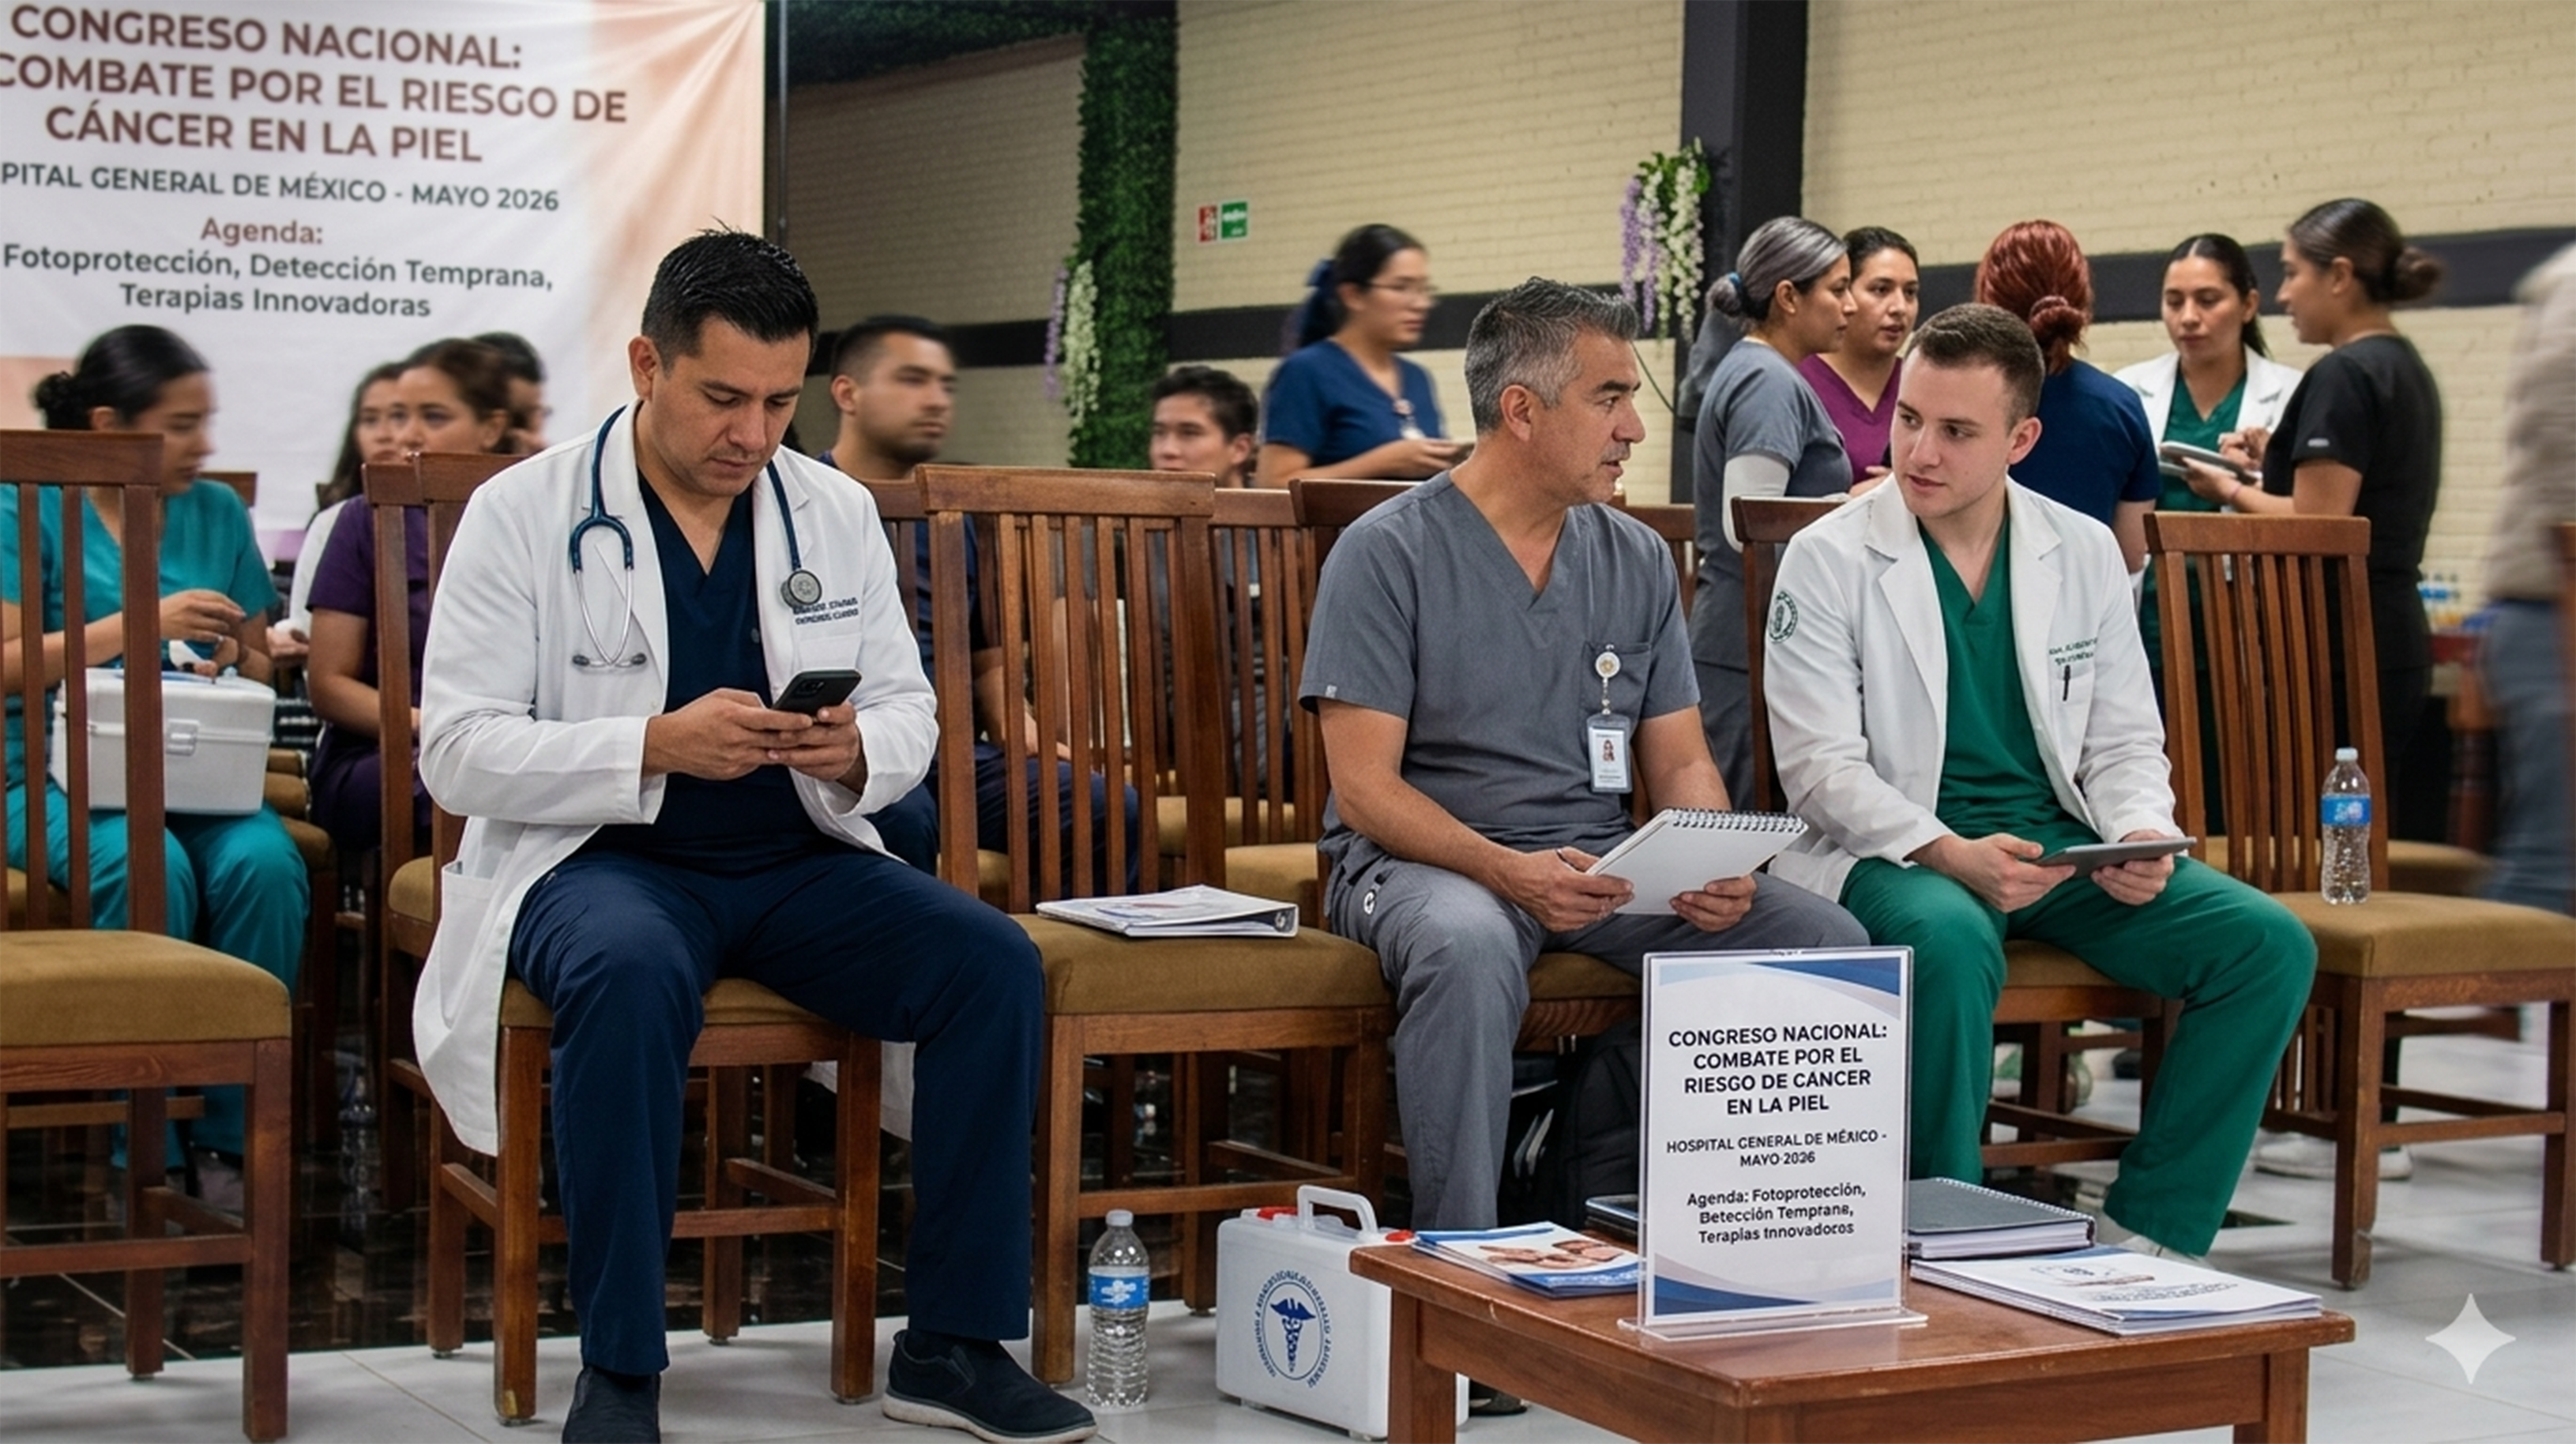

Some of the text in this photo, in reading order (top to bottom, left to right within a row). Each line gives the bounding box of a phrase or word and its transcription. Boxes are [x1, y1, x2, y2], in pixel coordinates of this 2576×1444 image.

[11, 4, 521, 69] CONGRESO NACIONAL:
[0, 52, 626, 123] COMBATE POR EL RIESGO DE
[46, 99, 482, 162] CÁNCER EN LA PIEL
[91, 166, 224, 194] GENERAL
[232, 173, 269, 197] DE
[279, 172, 386, 203] MÉXICO
[412, 184, 490, 208] MAYO
[497, 188, 559, 212] 2026
[200, 217, 322, 247] Agenda:
[4, 239, 552, 291] Fotoprotección, Detección Temprana,
[119, 283, 431, 317] Terapias Innovadoras
[1668, 1023, 1887, 1046] CONGRESO NACIONAL:
[1693, 1047, 1863, 1069] COMBATE POR EL
[1685, 1074, 1756, 1093] RIESGO
[1761, 1073, 1788, 1090] DE
[1727, 1094, 1829, 1115] EN LA PIEL
[1667, 1138, 1734, 1153] HOSPITAL
[1804, 1133, 1823, 1146] DE
[1740, 1152, 1780, 1167] MAYO
[1687, 1182, 1866, 1209] Agenda: Fotoprotección,
[1698, 1227, 1761, 1245] Terapias
